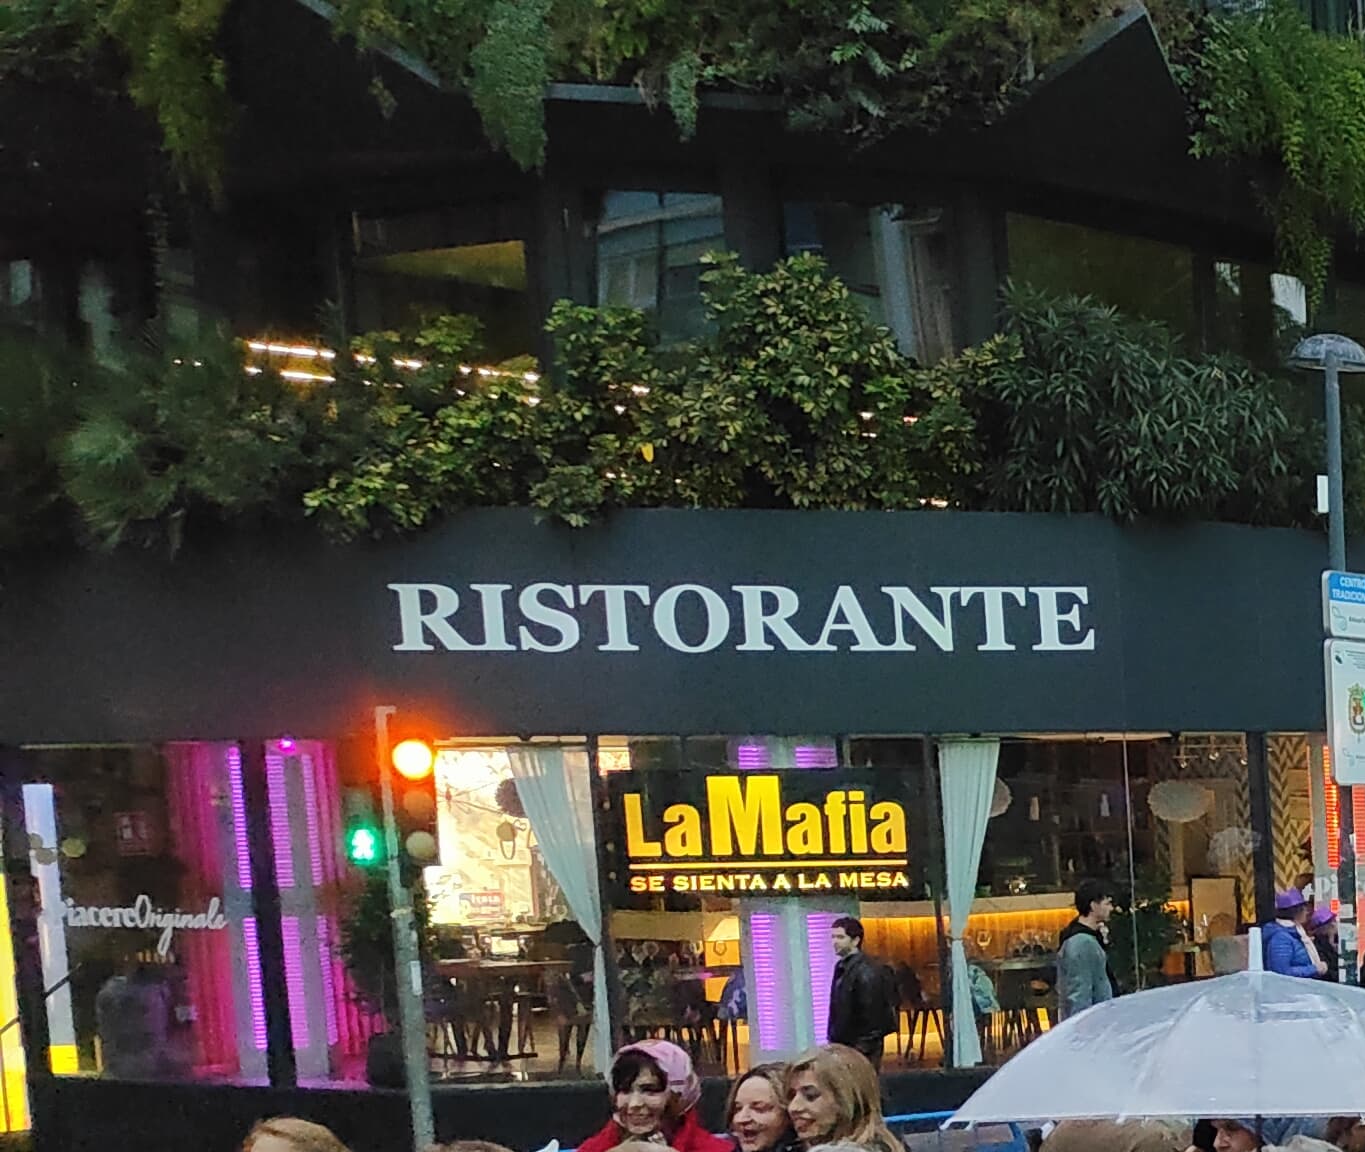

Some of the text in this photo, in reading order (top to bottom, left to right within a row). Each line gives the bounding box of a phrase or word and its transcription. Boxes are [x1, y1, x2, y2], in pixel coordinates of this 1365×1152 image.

[386, 582, 1096, 653] RISTORANTE
[630, 871, 909, 892] SE SIENTA A LA MESA
